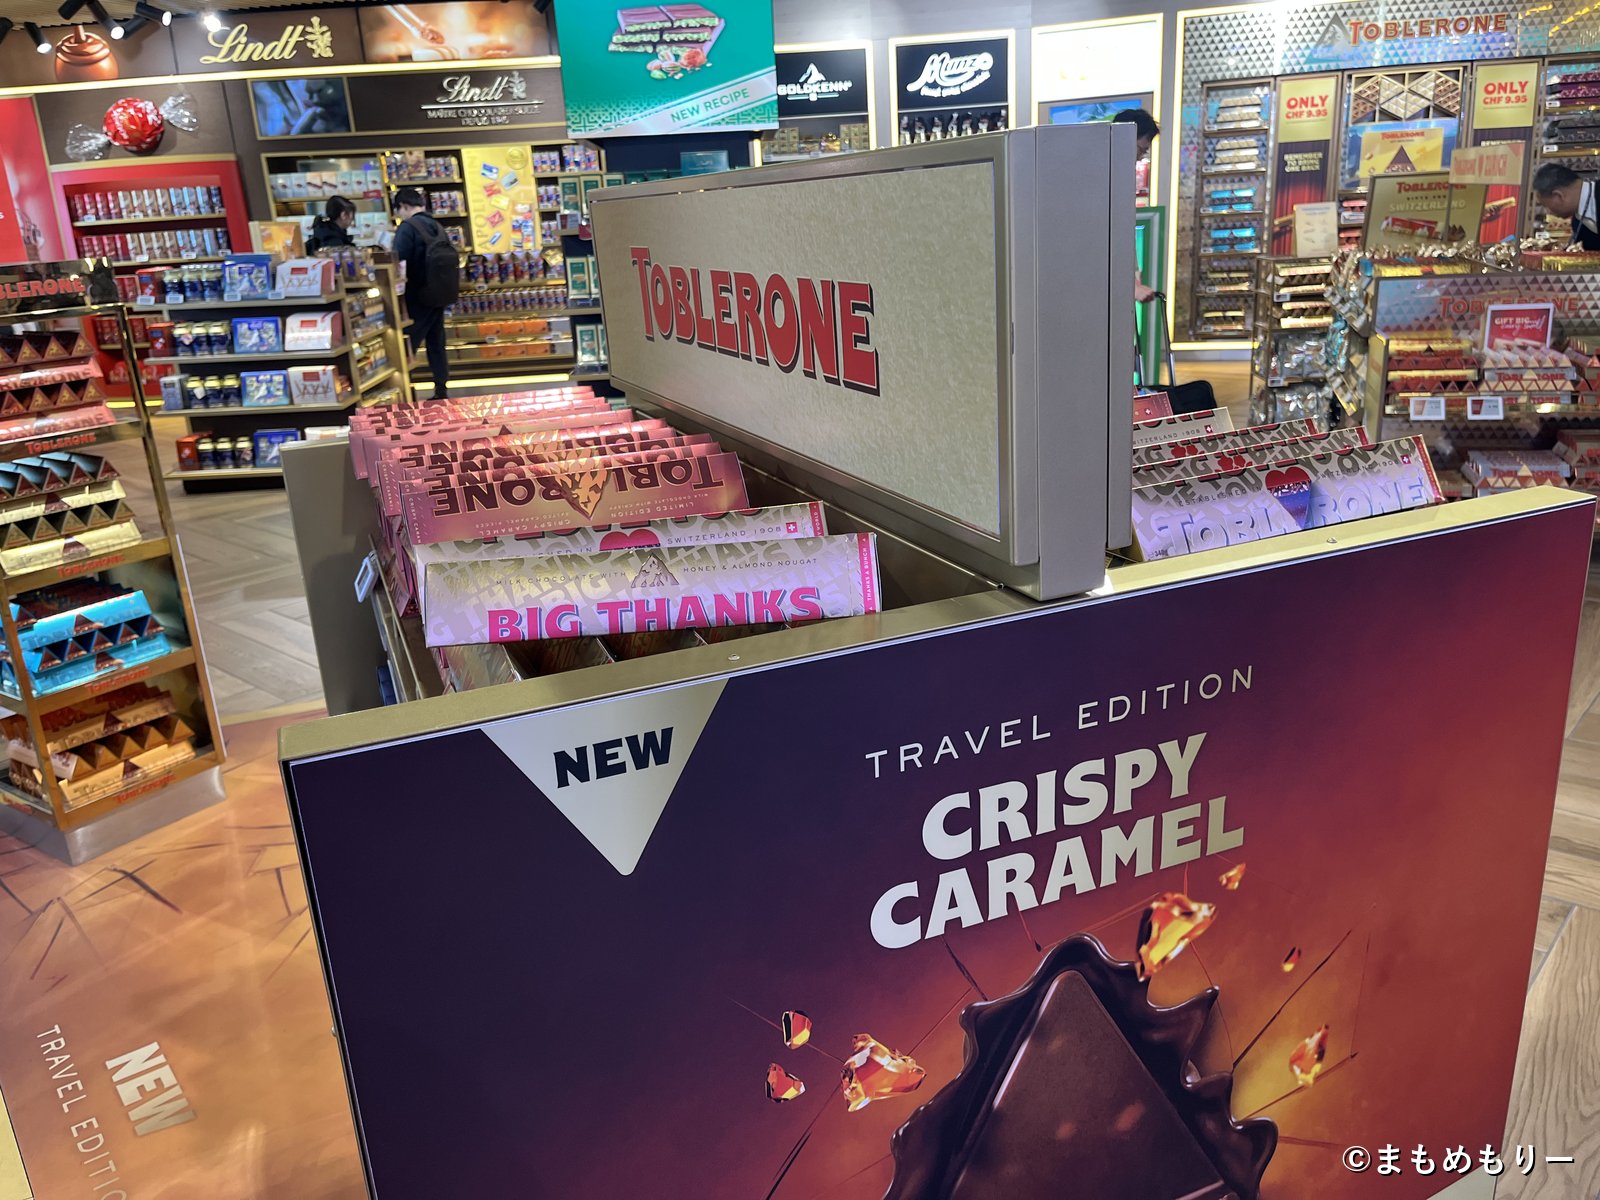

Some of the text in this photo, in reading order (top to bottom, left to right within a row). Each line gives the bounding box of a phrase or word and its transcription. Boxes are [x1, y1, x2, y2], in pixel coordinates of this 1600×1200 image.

[1349, 13, 1509, 46] TOBLERONE
[200, 23, 304, 64] Lindt
[436, 75, 509, 102] Lindt
[1482, 95, 1528, 105] CHF 9.95
[1483, 81, 1529, 95] ONLY
[670, 87, 750, 124] NEW RECIPE
[1285, 110, 1305, 119] CHF
[1286, 94, 1329, 110] ONLY
[1381, 131, 1425, 139] TOBLERONE
[629, 245, 880, 397] TOBLERONE
[25, 432, 96, 455] TOBLERONE
[609, 502, 694, 518] LIMITED EDITION
[479, 519, 572, 536] CRISPY CARAMEL
[667, 526, 783, 545] SWITZERLAND 1908
[528, 573, 594, 585] CHOCOLATE
[600, 571, 627, 580] WITH
[683, 564, 717, 573] HONEY
[732, 560, 774, 570] ALMOND
[777, 557, 818, 567] NOUGAT
[487, 587, 825, 644] BIG THANKS
[866, 665, 1254, 779] TRAVEL EDITION
[554, 726, 675, 789] NEW
[921, 732, 1208, 862] CRISPY
[868, 796, 1246, 949] CARAMEL
[37, 1024, 87, 1113] TRAVEL
[105, 1041, 197, 1137] NEW
